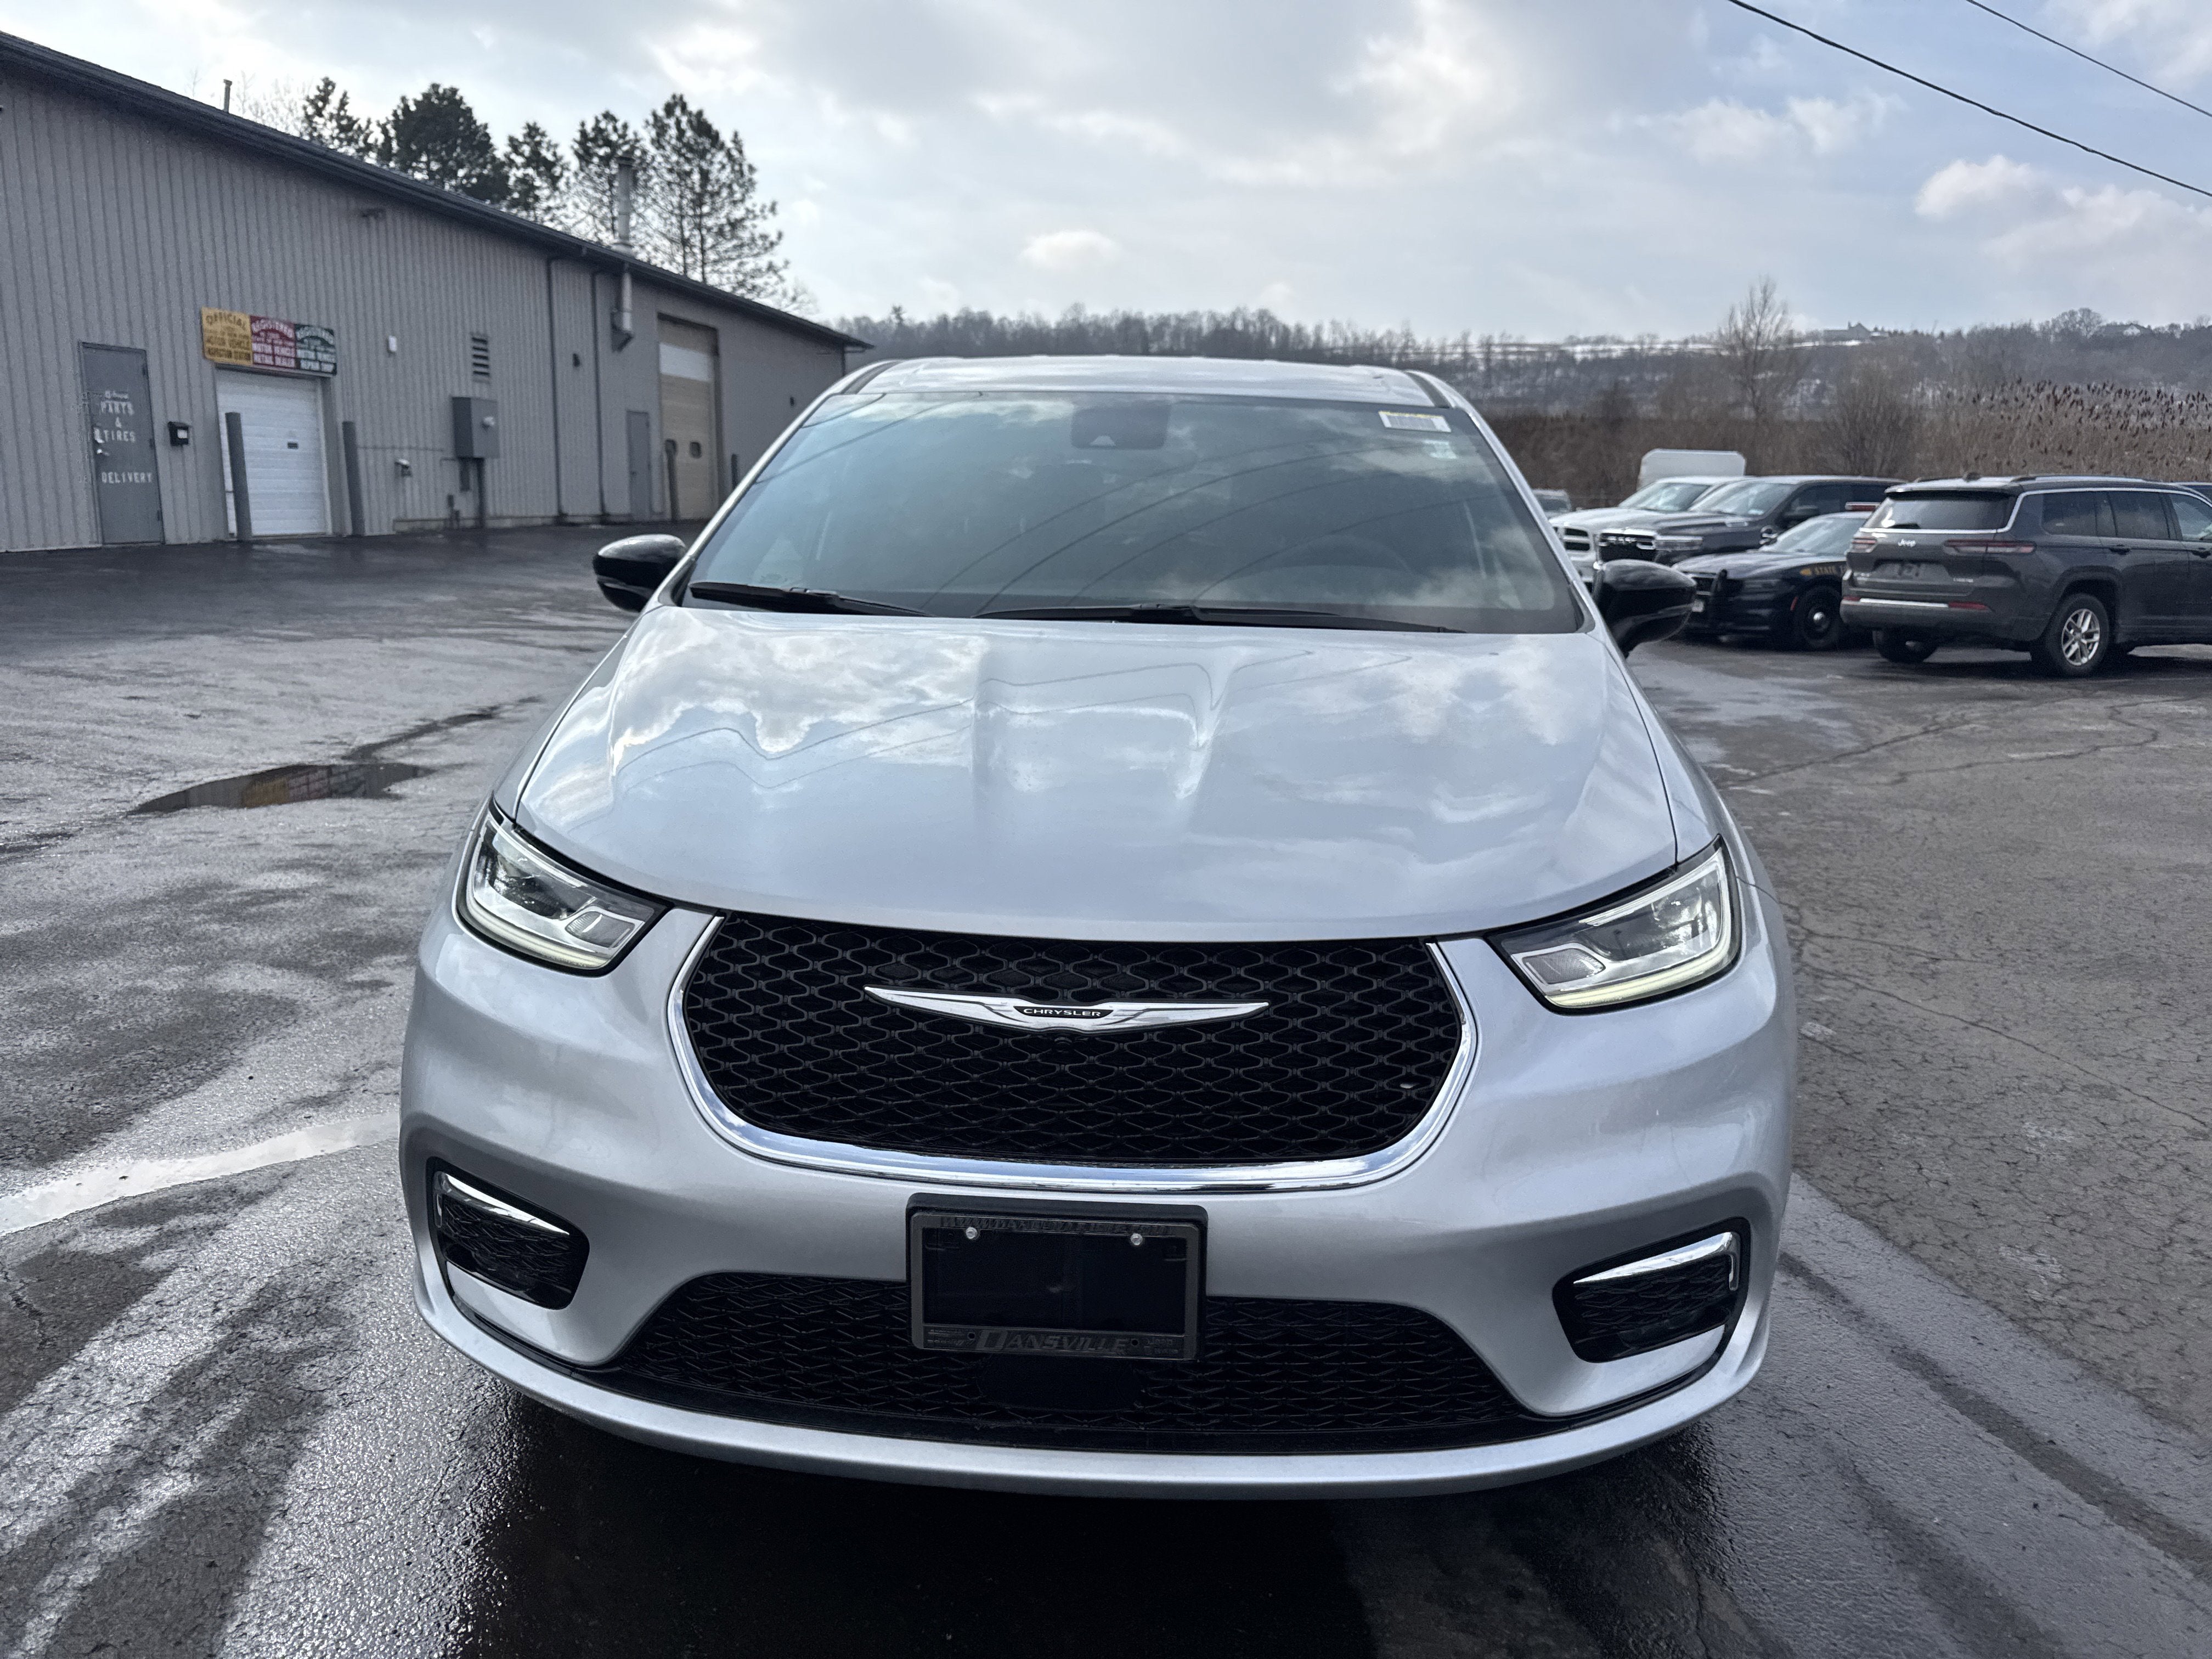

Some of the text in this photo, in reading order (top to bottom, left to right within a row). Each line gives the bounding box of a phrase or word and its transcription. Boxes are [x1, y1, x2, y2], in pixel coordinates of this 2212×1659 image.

[205, 311, 247, 330] OFFICIAL
[103, 430, 136, 443] TIRES
[101, 471, 153, 484] DELIVERY
[1898, 539, 1916, 548] Jeep
[1023, 1008, 1101, 1017] CHRYSLER
